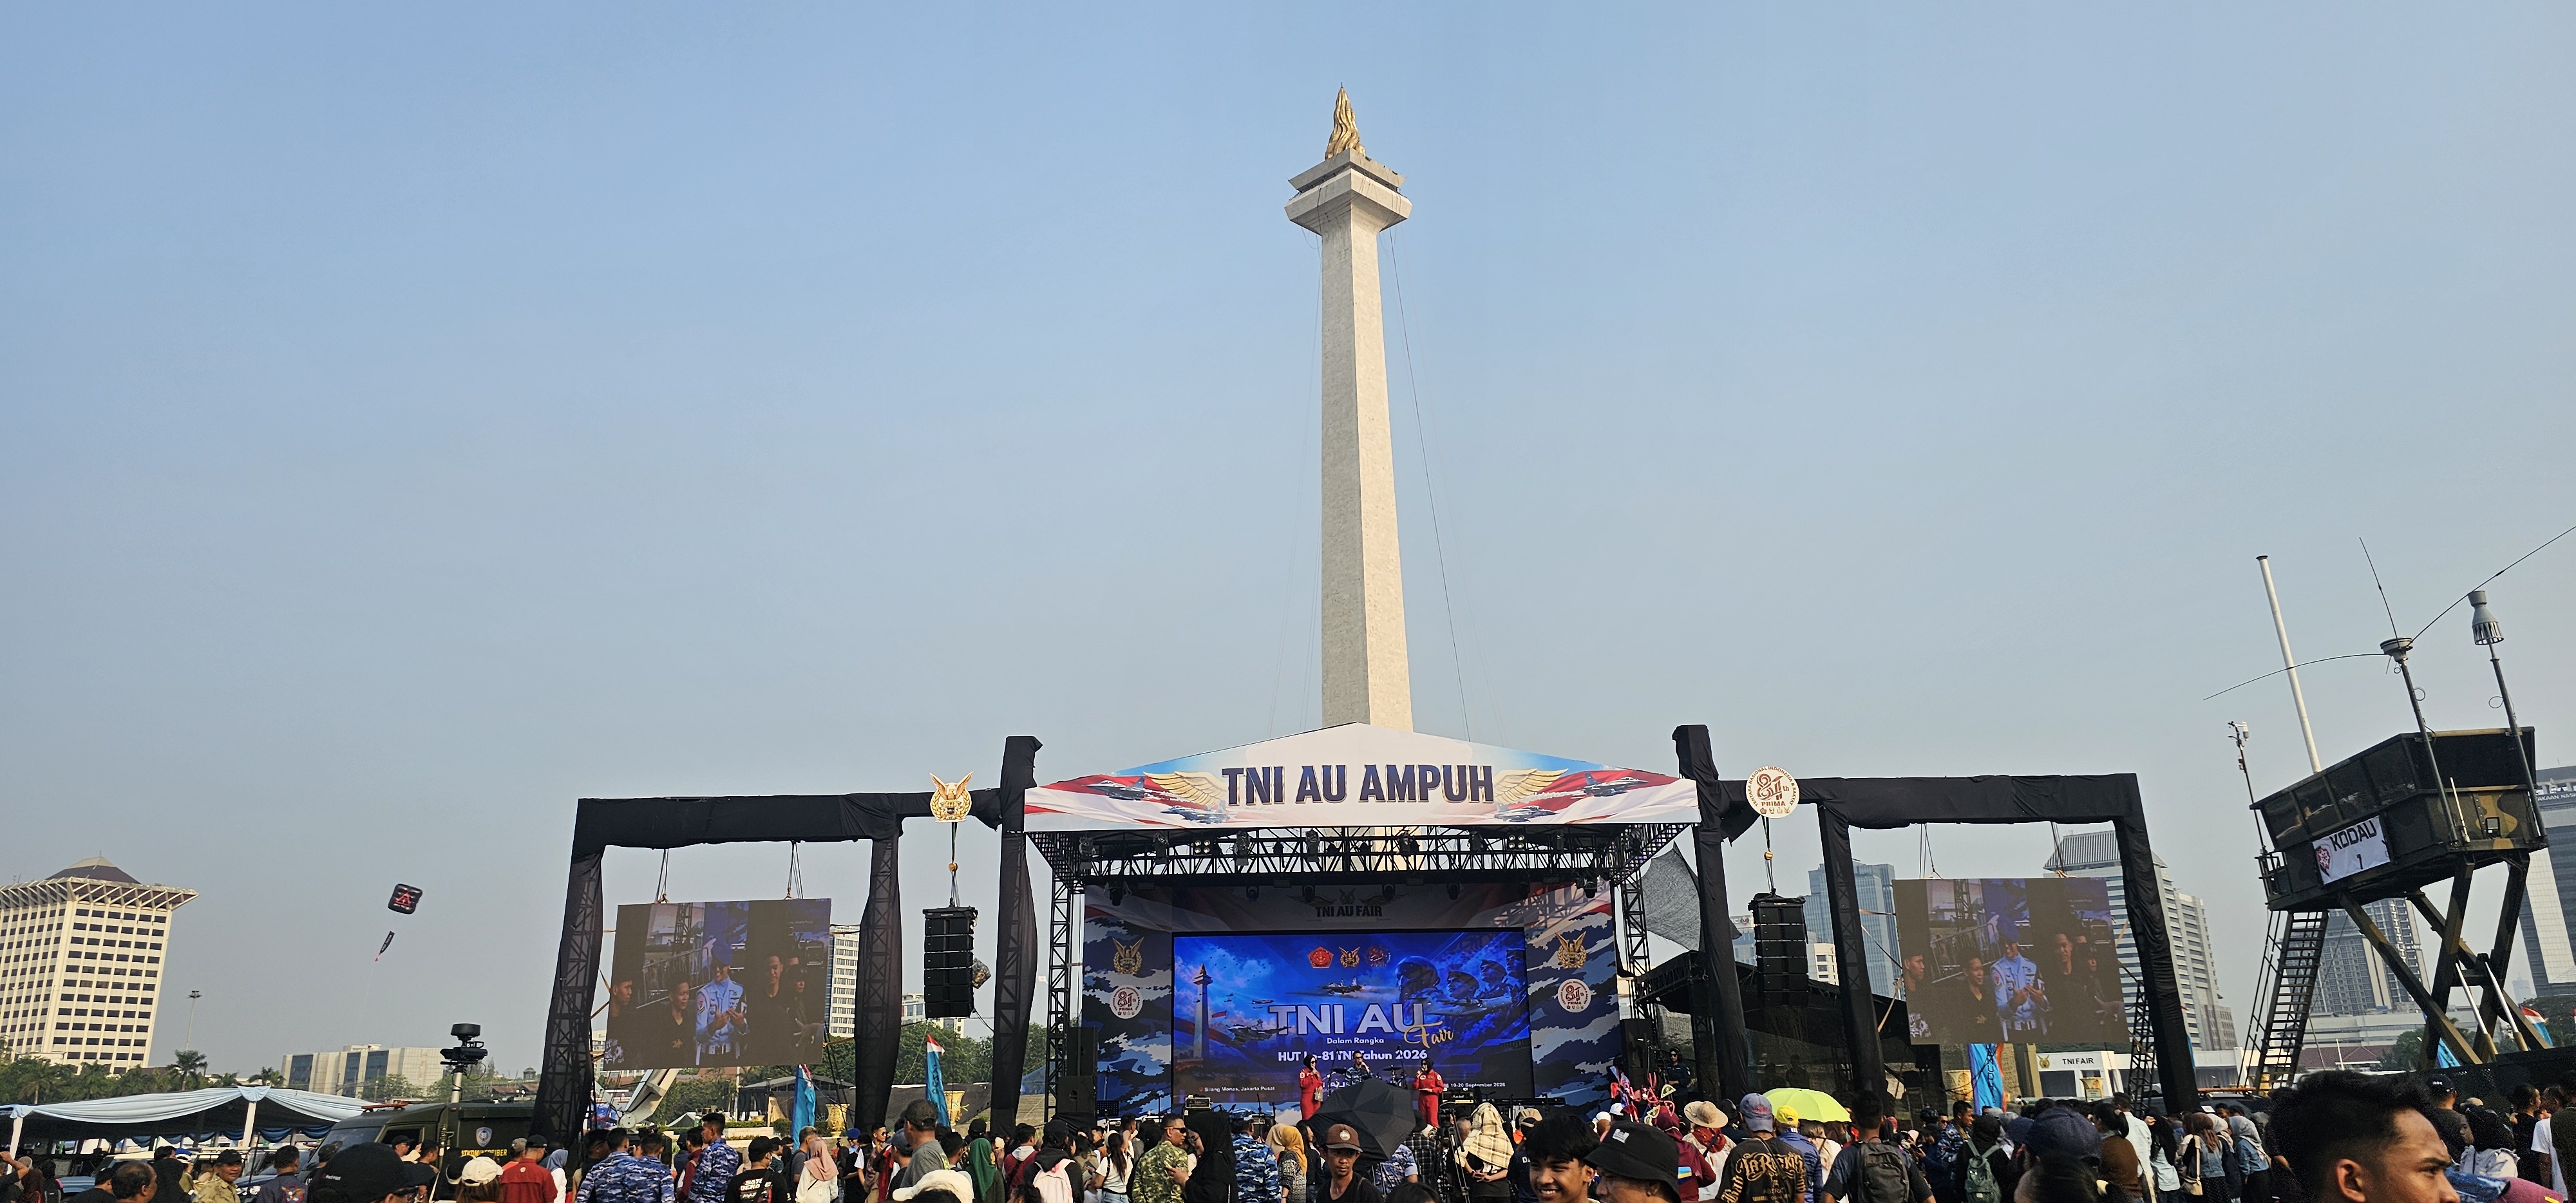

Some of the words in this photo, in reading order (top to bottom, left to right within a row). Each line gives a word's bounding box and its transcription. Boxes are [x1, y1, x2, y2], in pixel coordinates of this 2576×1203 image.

[1748, 766, 1767, 784] NASIONAL
[1768, 766, 1793, 782] INDONESIA
[1222, 766, 1285, 806] TNI
[1295, 764, 1348, 804] AU
[1358, 764, 1494, 804] AMPUH
[2329, 820, 2378, 851] KODAU
[2356, 853, 2363, 870] 1
[1315, 906, 1334, 918] TNI
[1336, 905, 1354, 917] AU
[1356, 905, 1383, 917] FAIR
[1269, 1003, 1345, 1035] TNI
[1356, 1003, 1424, 1034] AU
[1354, 1037, 1384, 1045] Rangka
[1404, 1020, 1454, 1048] Fair
[1278, 1051, 1301, 1061] HUT
[1395, 1049, 1427, 1059] 2026
